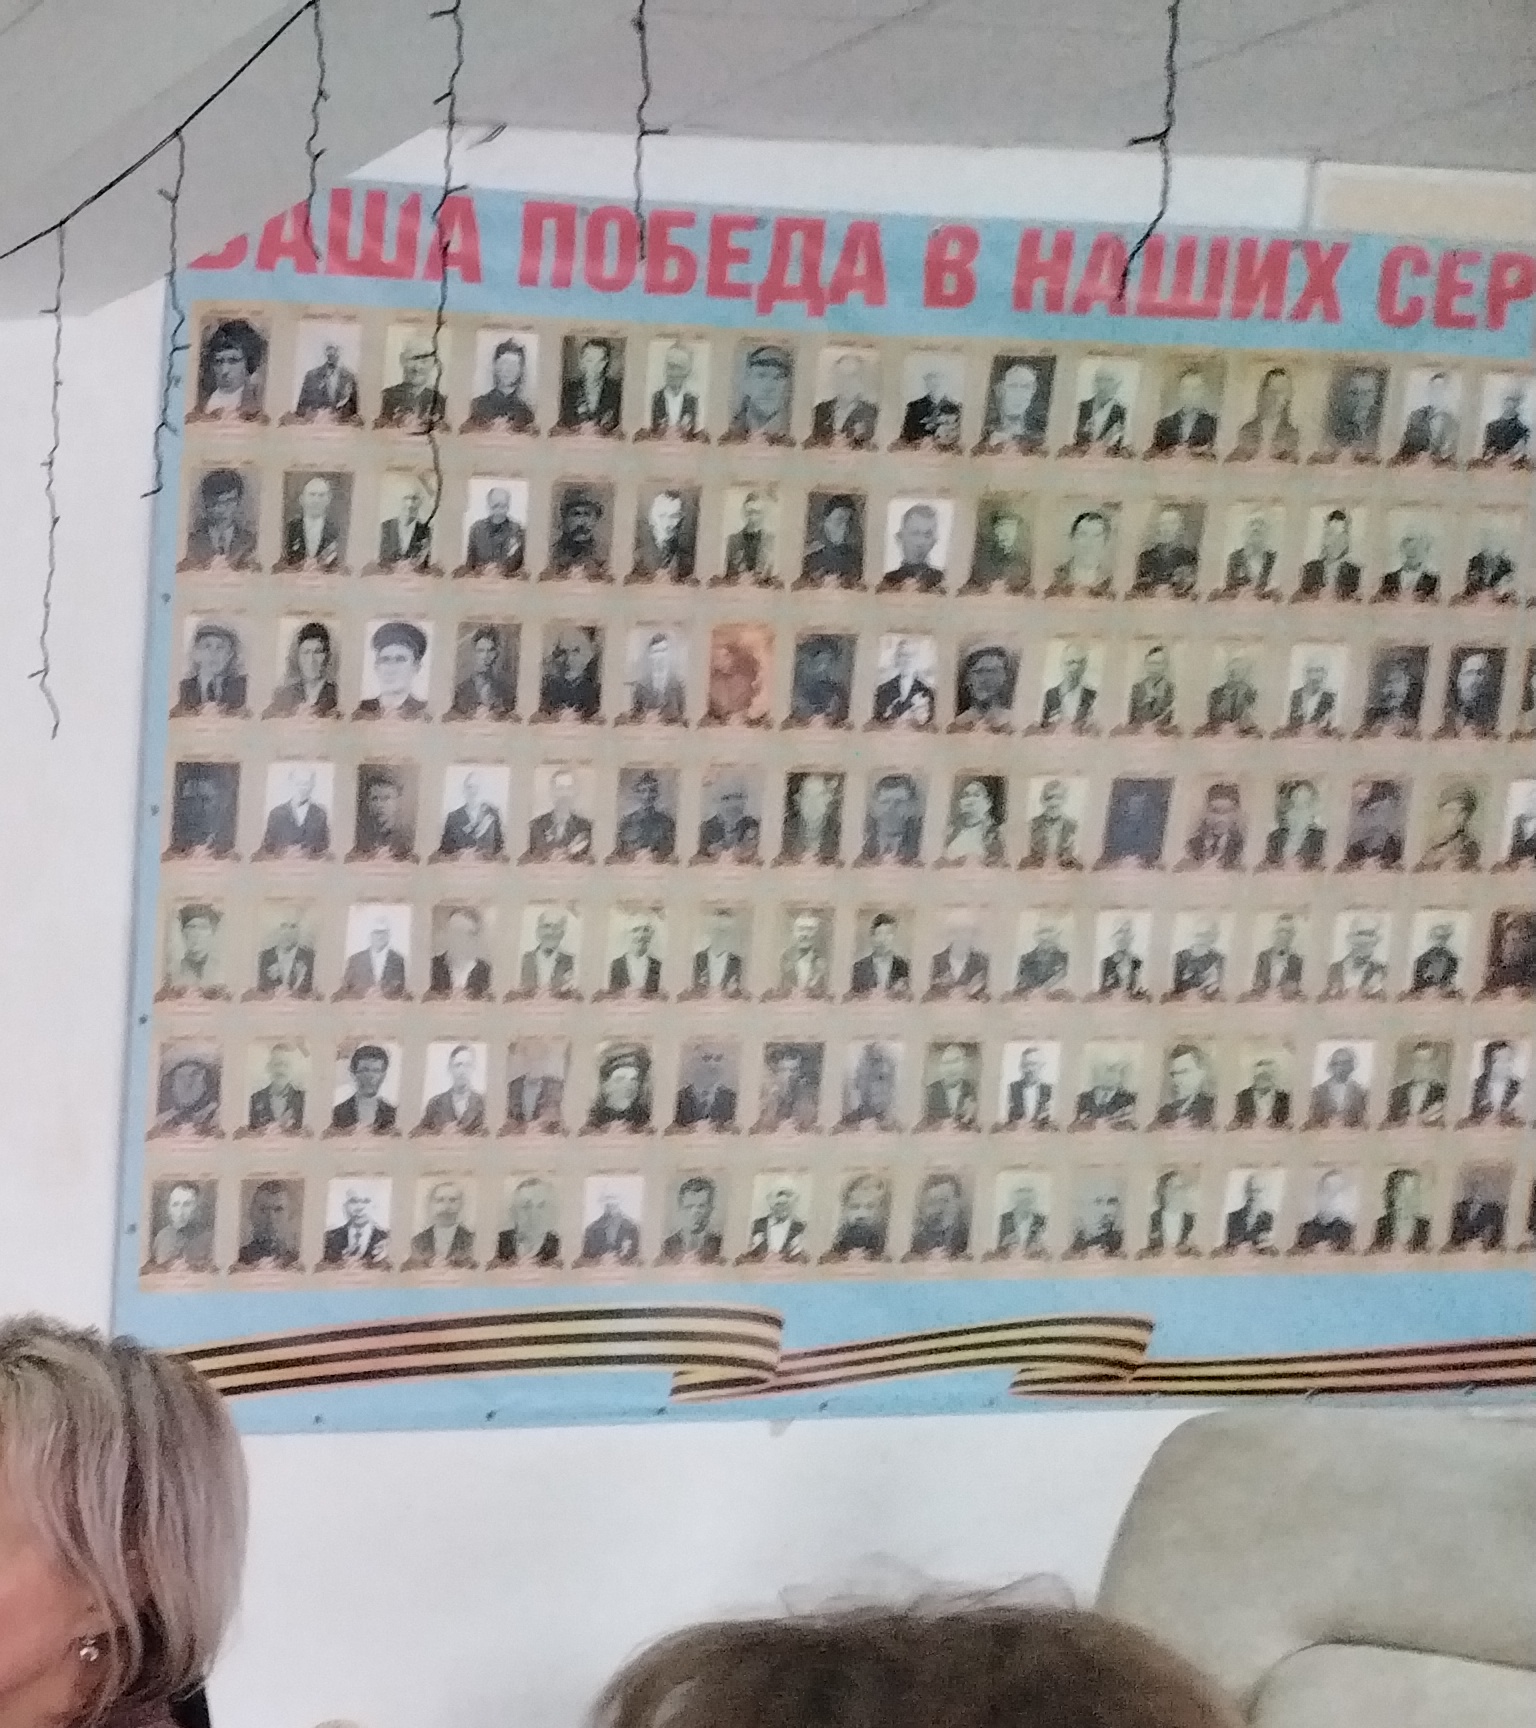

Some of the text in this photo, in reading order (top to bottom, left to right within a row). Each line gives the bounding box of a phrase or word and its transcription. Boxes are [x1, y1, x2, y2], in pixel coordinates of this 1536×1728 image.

[518, 200, 888, 317] ПОБЕДА
[921, 224, 981, 310] В
[1011, 227, 1352, 325] НАШИХ
[1375, 245, 1536, 331] СЕР
